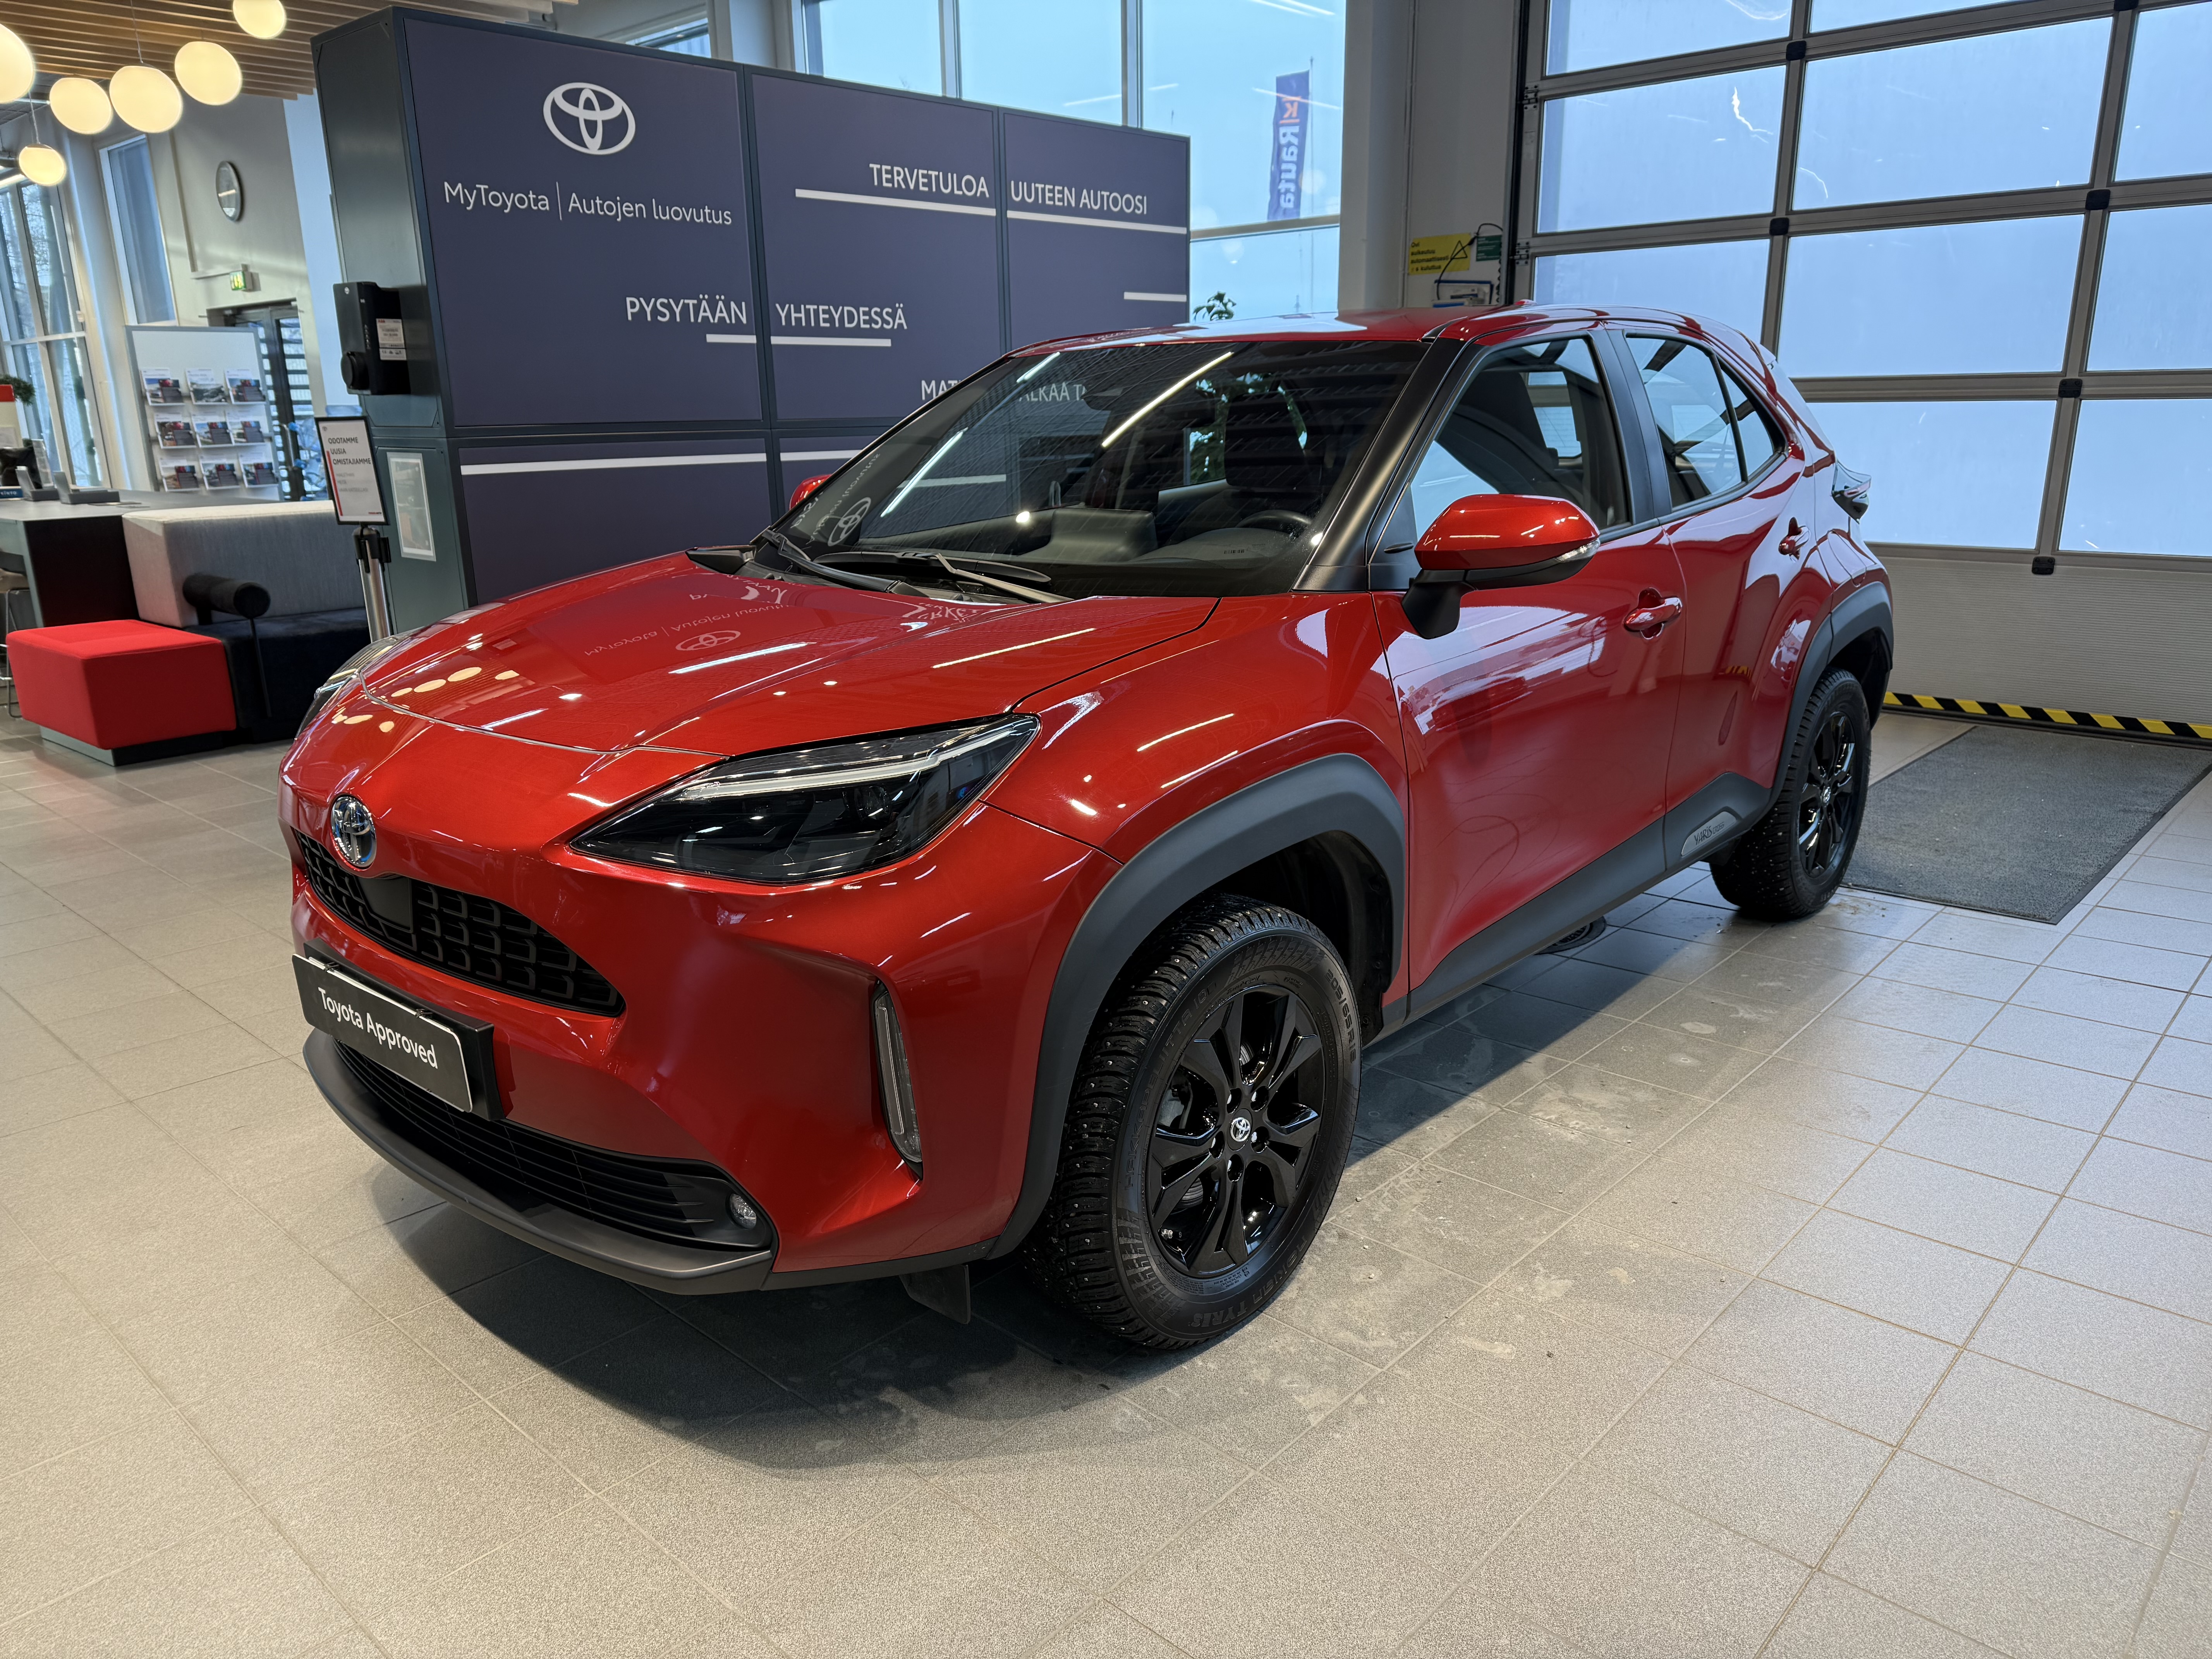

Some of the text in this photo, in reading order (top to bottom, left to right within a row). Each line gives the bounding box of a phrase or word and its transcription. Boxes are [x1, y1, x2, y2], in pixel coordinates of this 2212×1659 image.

[444, 181, 732, 225] MyToyota Autojen luovutus
[869, 163, 1147, 215] TERVETULOA UUTEEN AUTOOSI
[626, 294, 907, 330] PYSYTÄÄN YHTEYDESSÄ
[318, 987, 438, 1069] Toyota Approved
[1191, 1300, 1247, 1328] TYRES
